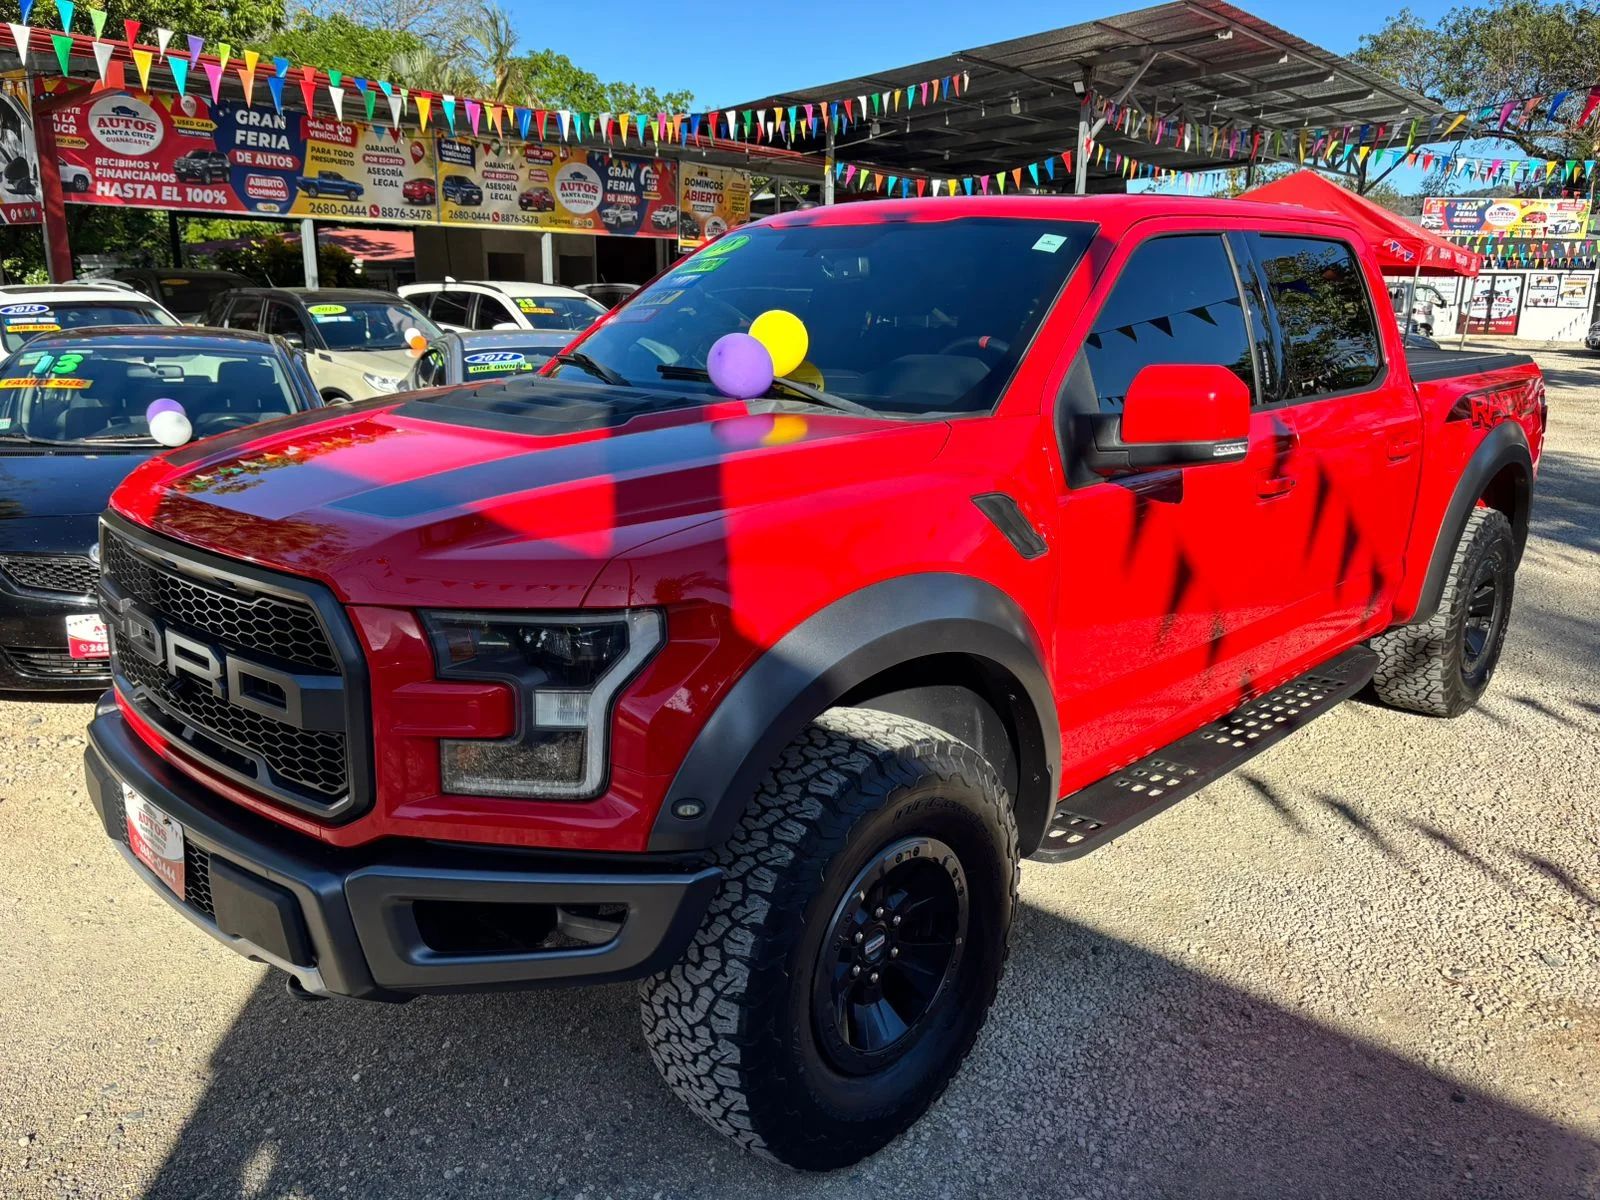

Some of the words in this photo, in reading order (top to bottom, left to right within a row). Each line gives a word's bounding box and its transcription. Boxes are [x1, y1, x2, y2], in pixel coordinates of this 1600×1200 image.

[62, 113, 76, 124] LA
[176, 119, 195, 127] USED
[195, 121, 214, 129] CARS
[235, 109, 286, 129] GRAN
[53, 123, 77, 134] UCR
[97, 117, 157, 133] AUTOS
[325, 123, 335, 132] DE
[100, 128, 131, 137] SANTA
[131, 131, 155, 140] CRUZ
[106, 137, 151, 146] GUANACASTE
[235, 130, 290, 150] FERIA
[311, 146, 331, 155] PARA
[334, 149, 354, 158] TODO
[365, 143, 401, 154] GARANTÍA
[95, 157, 150, 169] RECIBIMOS
[152, 162, 160, 170] Y
[236, 151, 252, 163] DE
[255, 153, 294, 168] AUTOS
[311, 155, 355, 166] PRESUPUESTO
[365, 155, 378, 163] POR
[379, 157, 404, 165] ESCRITO
[485, 161, 515, 170] GARANTÍA
[95, 168, 177, 183] FINANCIAMOS
[367, 167, 404, 177] ASESORÍA
[608, 166, 635, 179] GRAN
[248, 177, 284, 188] ABIERTO
[373, 178, 399, 188] LEGAL
[485, 182, 517, 193] ASESORÍA
[560, 182, 599, 194] AUTOS
[607, 180, 636, 192] FERIA
[684, 178, 724, 190] DOMINGOS
[96, 181, 157, 199] HASTA
[161, 185, 182, 201] EL
[186, 187, 228, 205] 100%
[248, 187, 286, 197] DOMINGOS
[490, 192, 513, 201] LEGAL
[683, 190, 724, 204] ABIERTO
[606, 194, 616, 202] DE
[616, 195, 637, 204] AUTOS
[309, 203, 367, 216] 2680-0444
[381, 206, 432, 220] 8876-5478
[448, 210, 490, 222] 2680-0444
[501, 213, 539, 224] 8876-5478
[8, 305, 38, 314] 2015
[479, 353, 513, 362] 2014
[55, 379, 87, 387] SIZE
[138, 811, 167, 842] AUTOS
